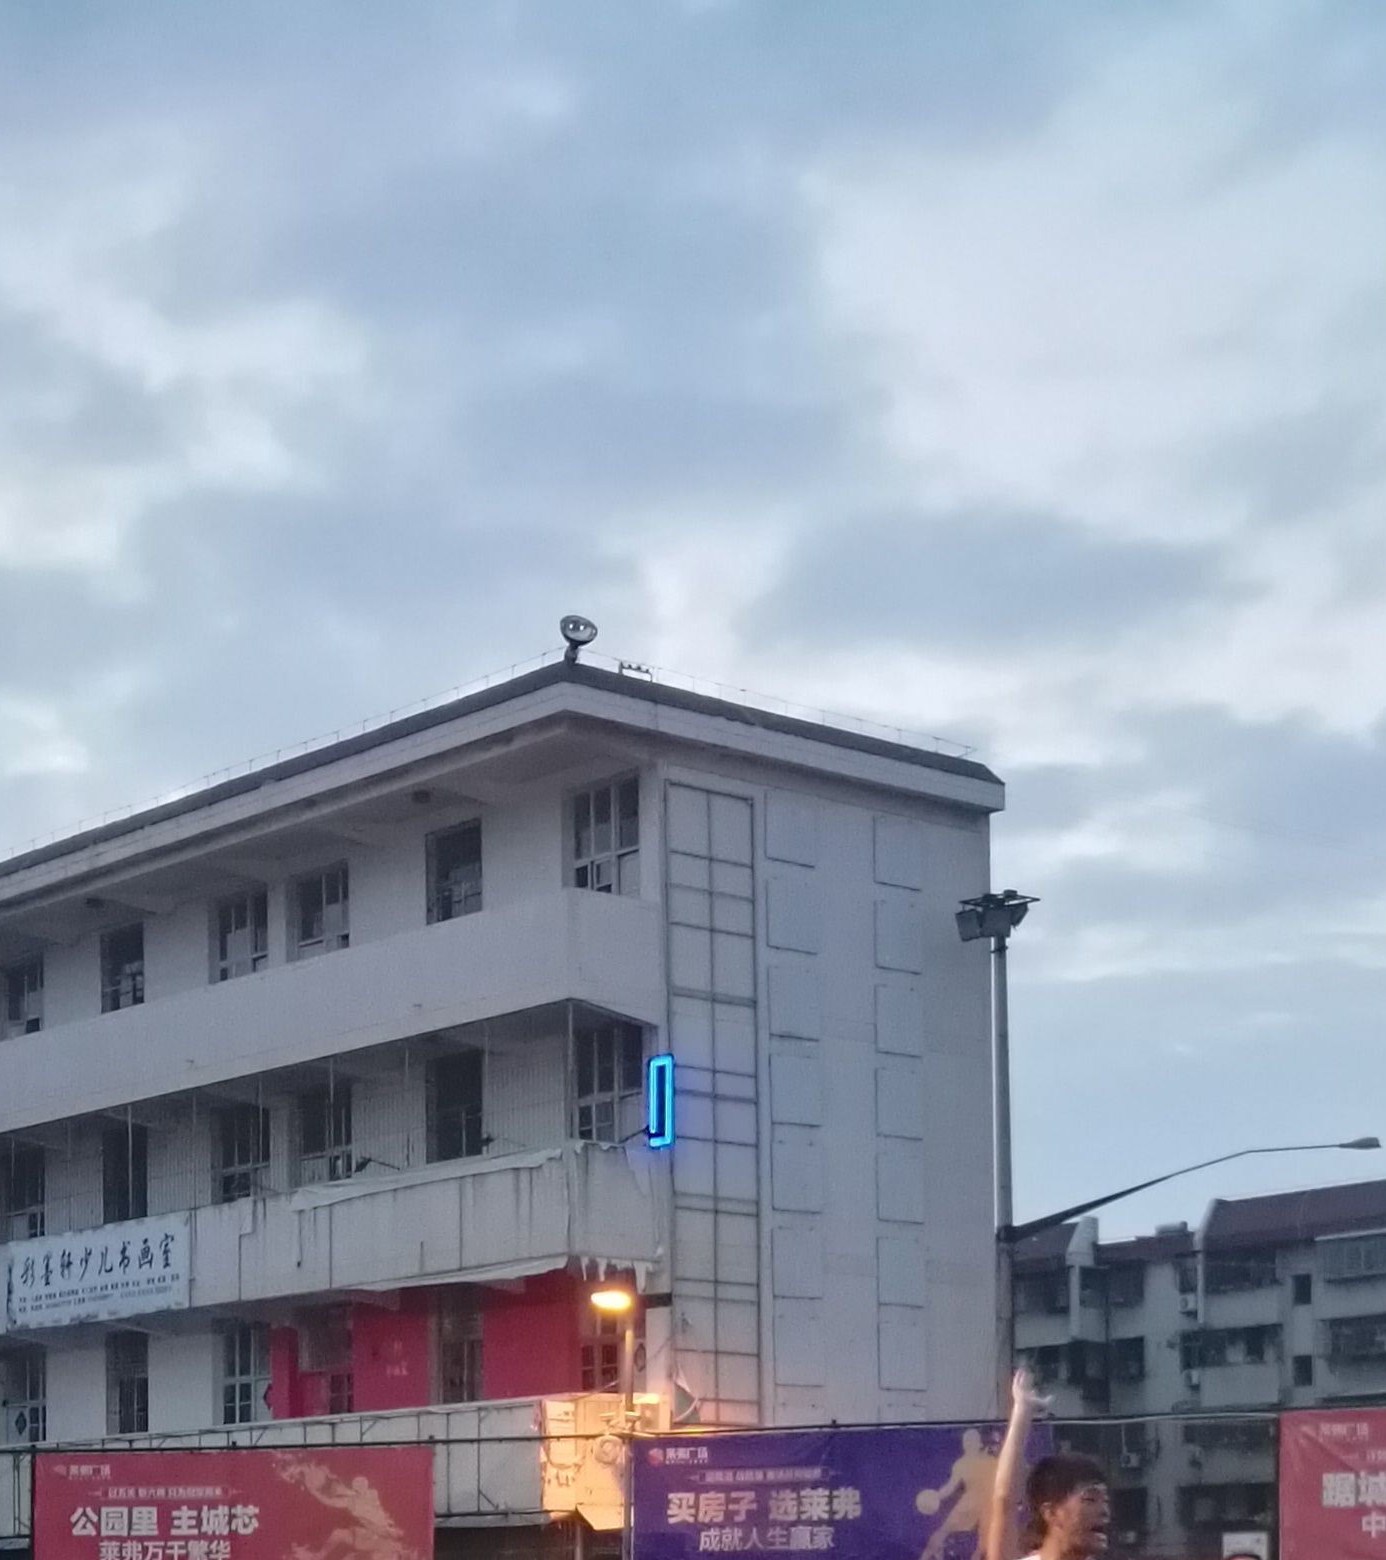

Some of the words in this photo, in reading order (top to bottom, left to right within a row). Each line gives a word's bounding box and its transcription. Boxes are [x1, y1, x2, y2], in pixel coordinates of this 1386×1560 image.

[69, 1506, 159, 1536] 公园里
[170, 1504, 260, 1536] 主城芯
[667, 1491, 758, 1524] 买房子
[768, 1486, 863, 1521] 选莱弗
[699, 1525, 835, 1551] 成就人生赢家
